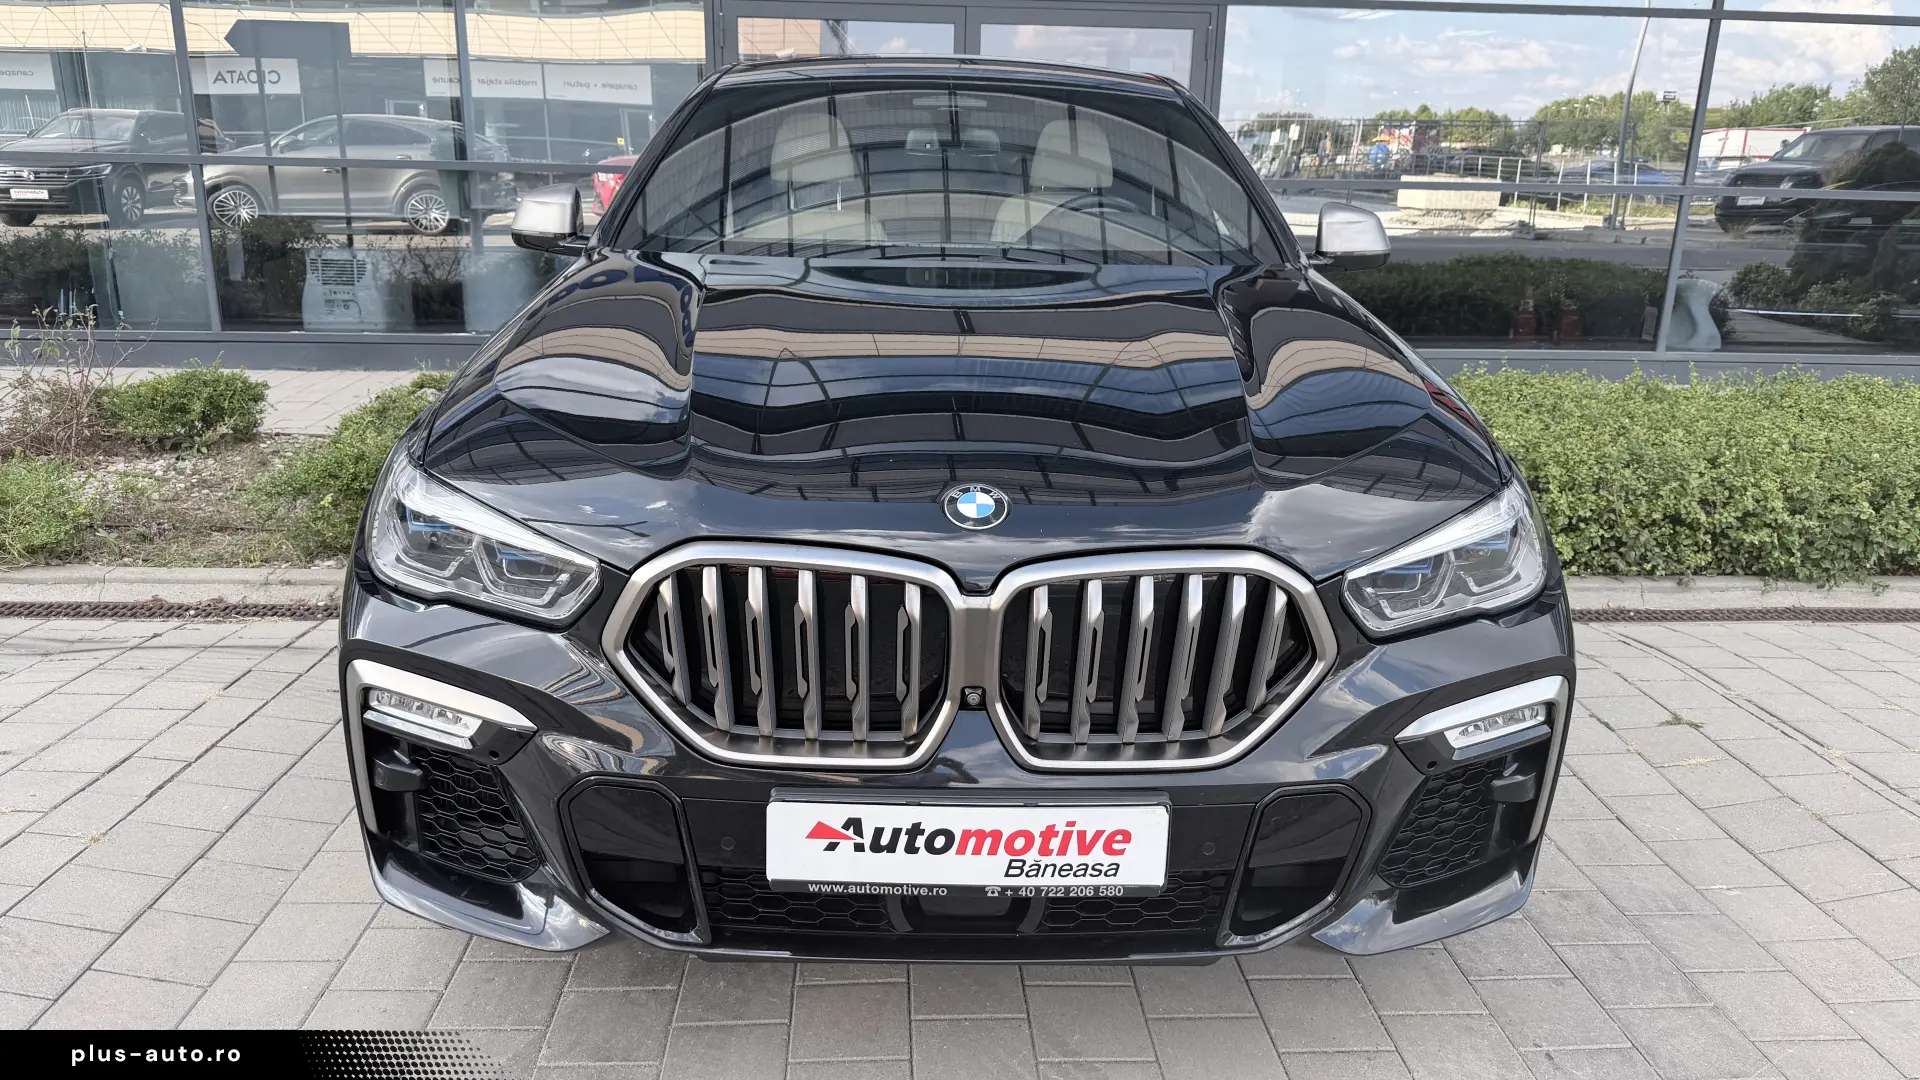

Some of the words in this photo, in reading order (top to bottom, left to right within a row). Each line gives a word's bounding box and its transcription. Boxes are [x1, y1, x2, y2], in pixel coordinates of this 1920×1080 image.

[951, 486, 1001, 499] BMW
[806, 817, 1132, 856] Automotive
[1004, 858, 1121, 878] Băneasa
[808, 883, 948, 896] www.automotive.ro
[1018, 886, 1036, 897] 40
[1041, 886, 1065, 897] 722
[1069, 886, 1094, 897] 206
[1098, 885, 1124, 897] 580
